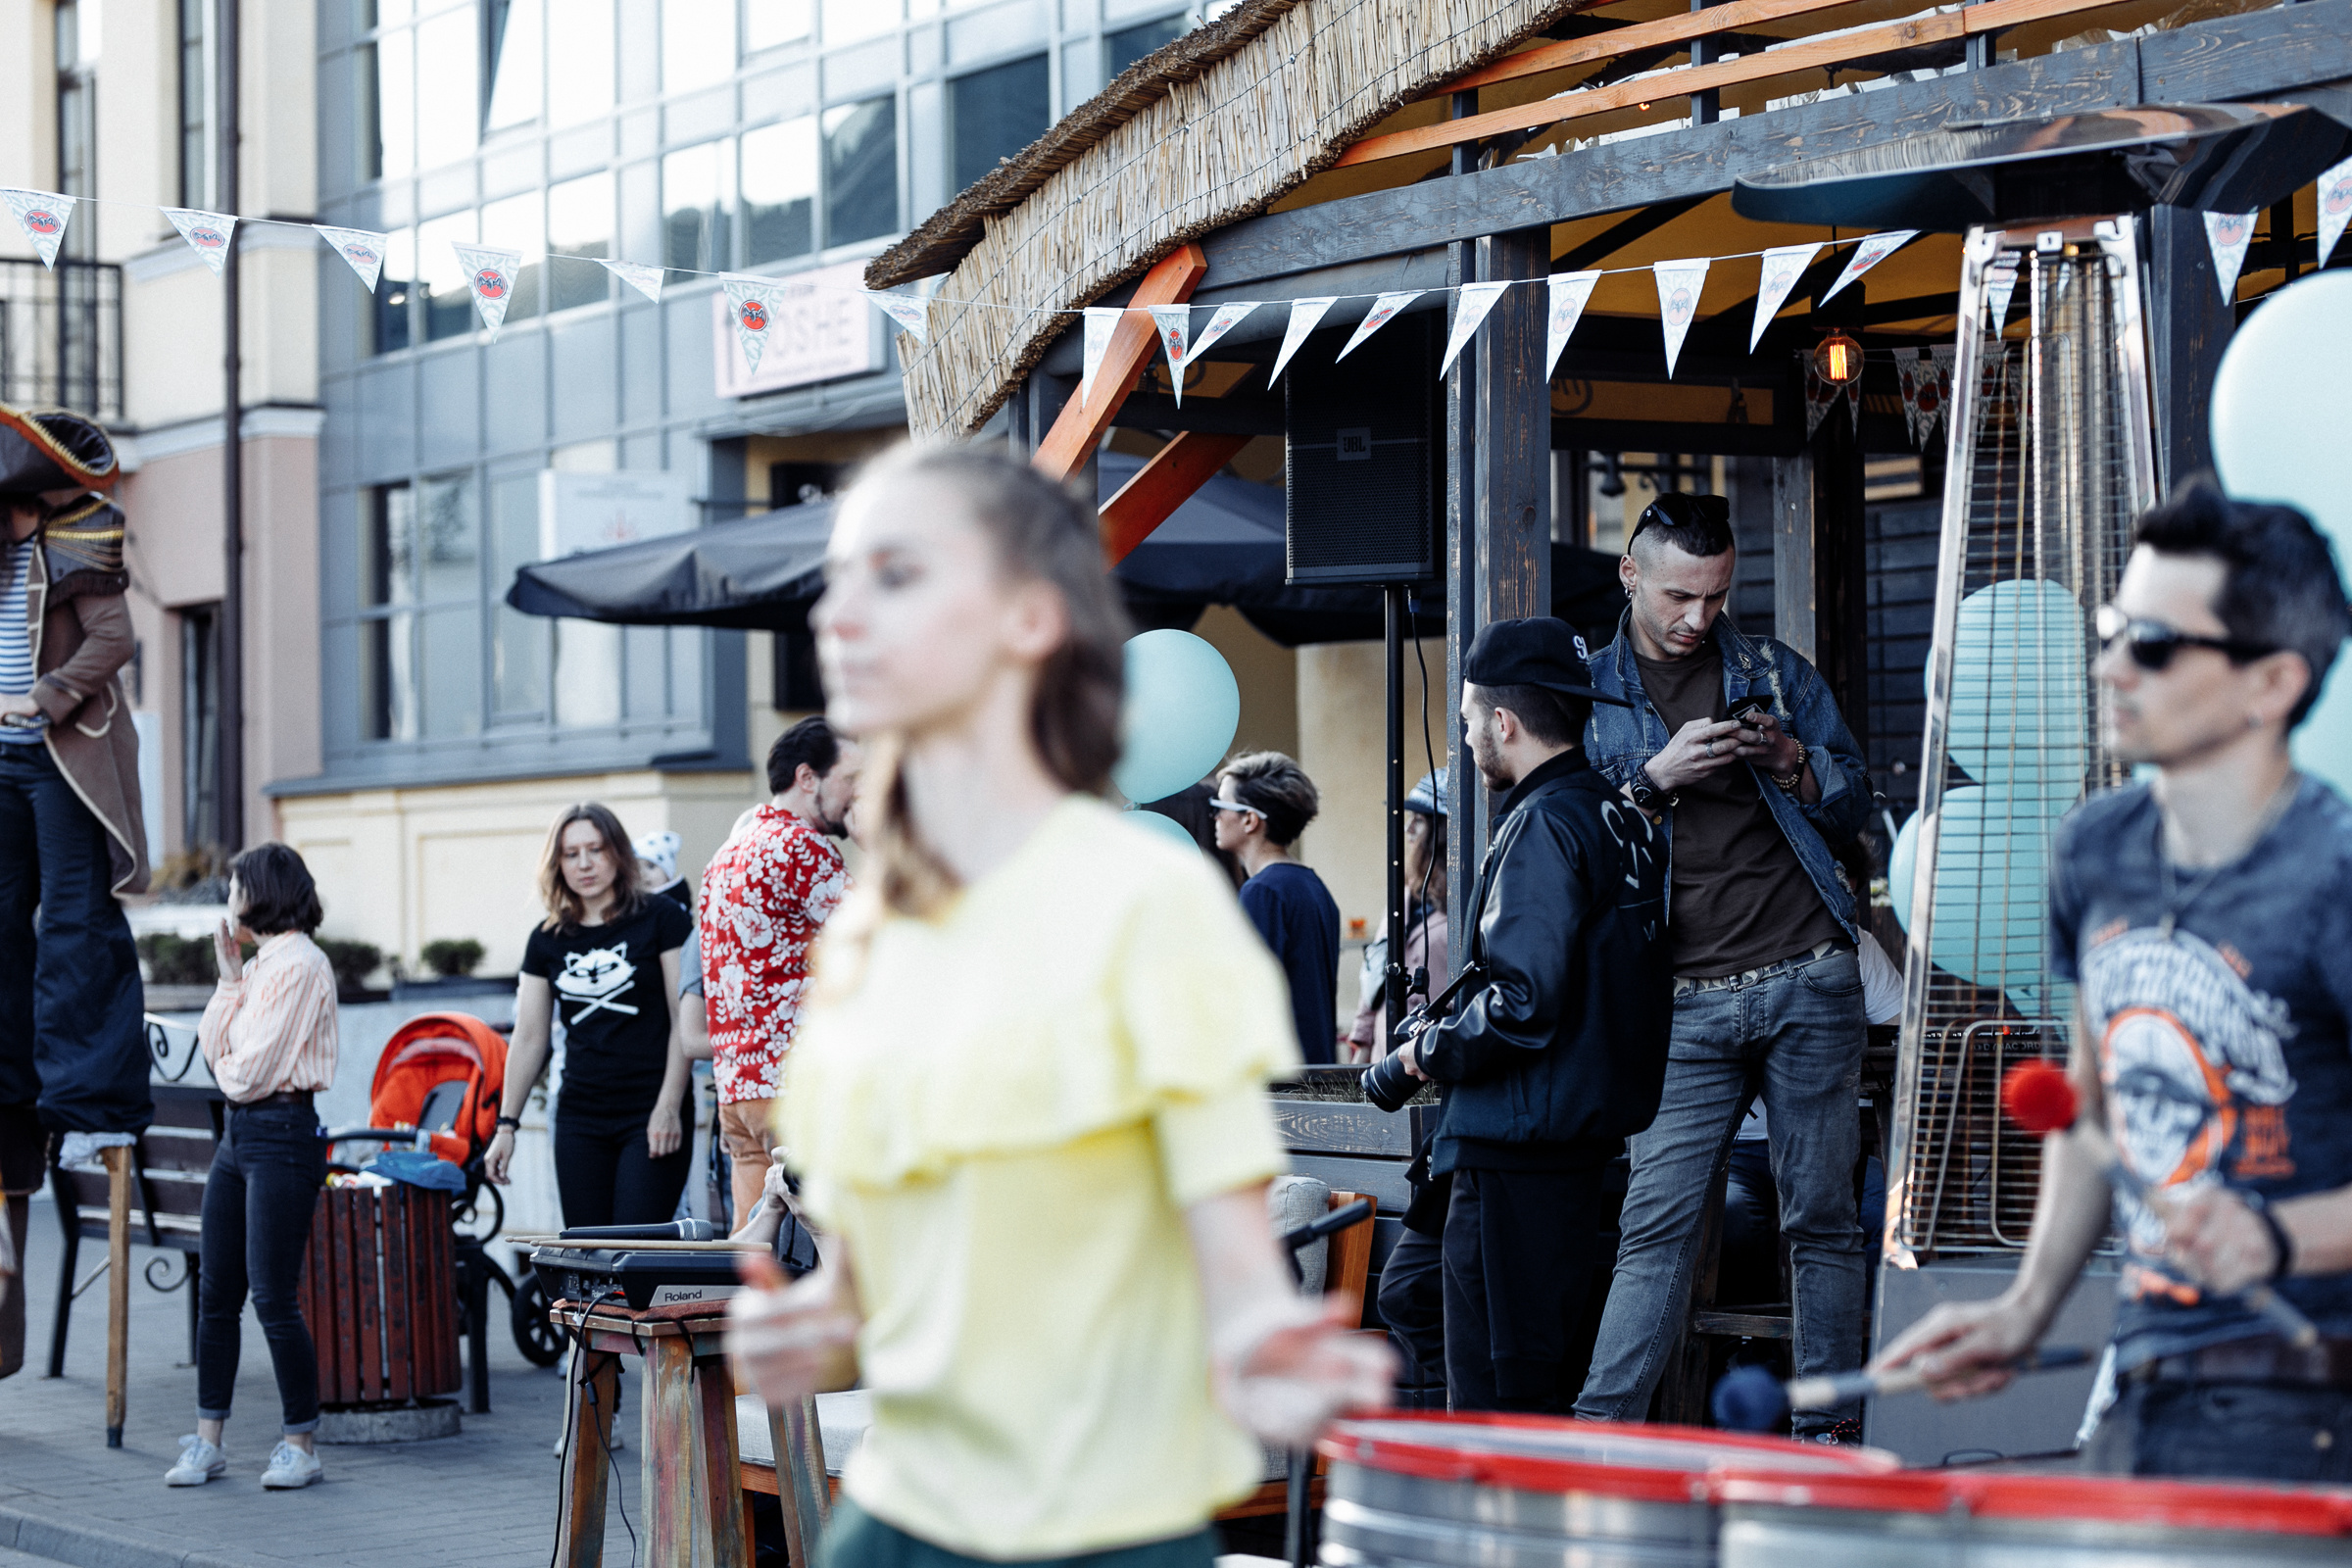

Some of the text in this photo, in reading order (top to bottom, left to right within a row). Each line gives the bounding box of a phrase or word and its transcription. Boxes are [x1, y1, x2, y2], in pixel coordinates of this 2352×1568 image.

[1343, 435, 1366, 453] JBL
[1983, 1041, 2041, 1052] DACORD
[664, 1289, 703, 1302] Roland
